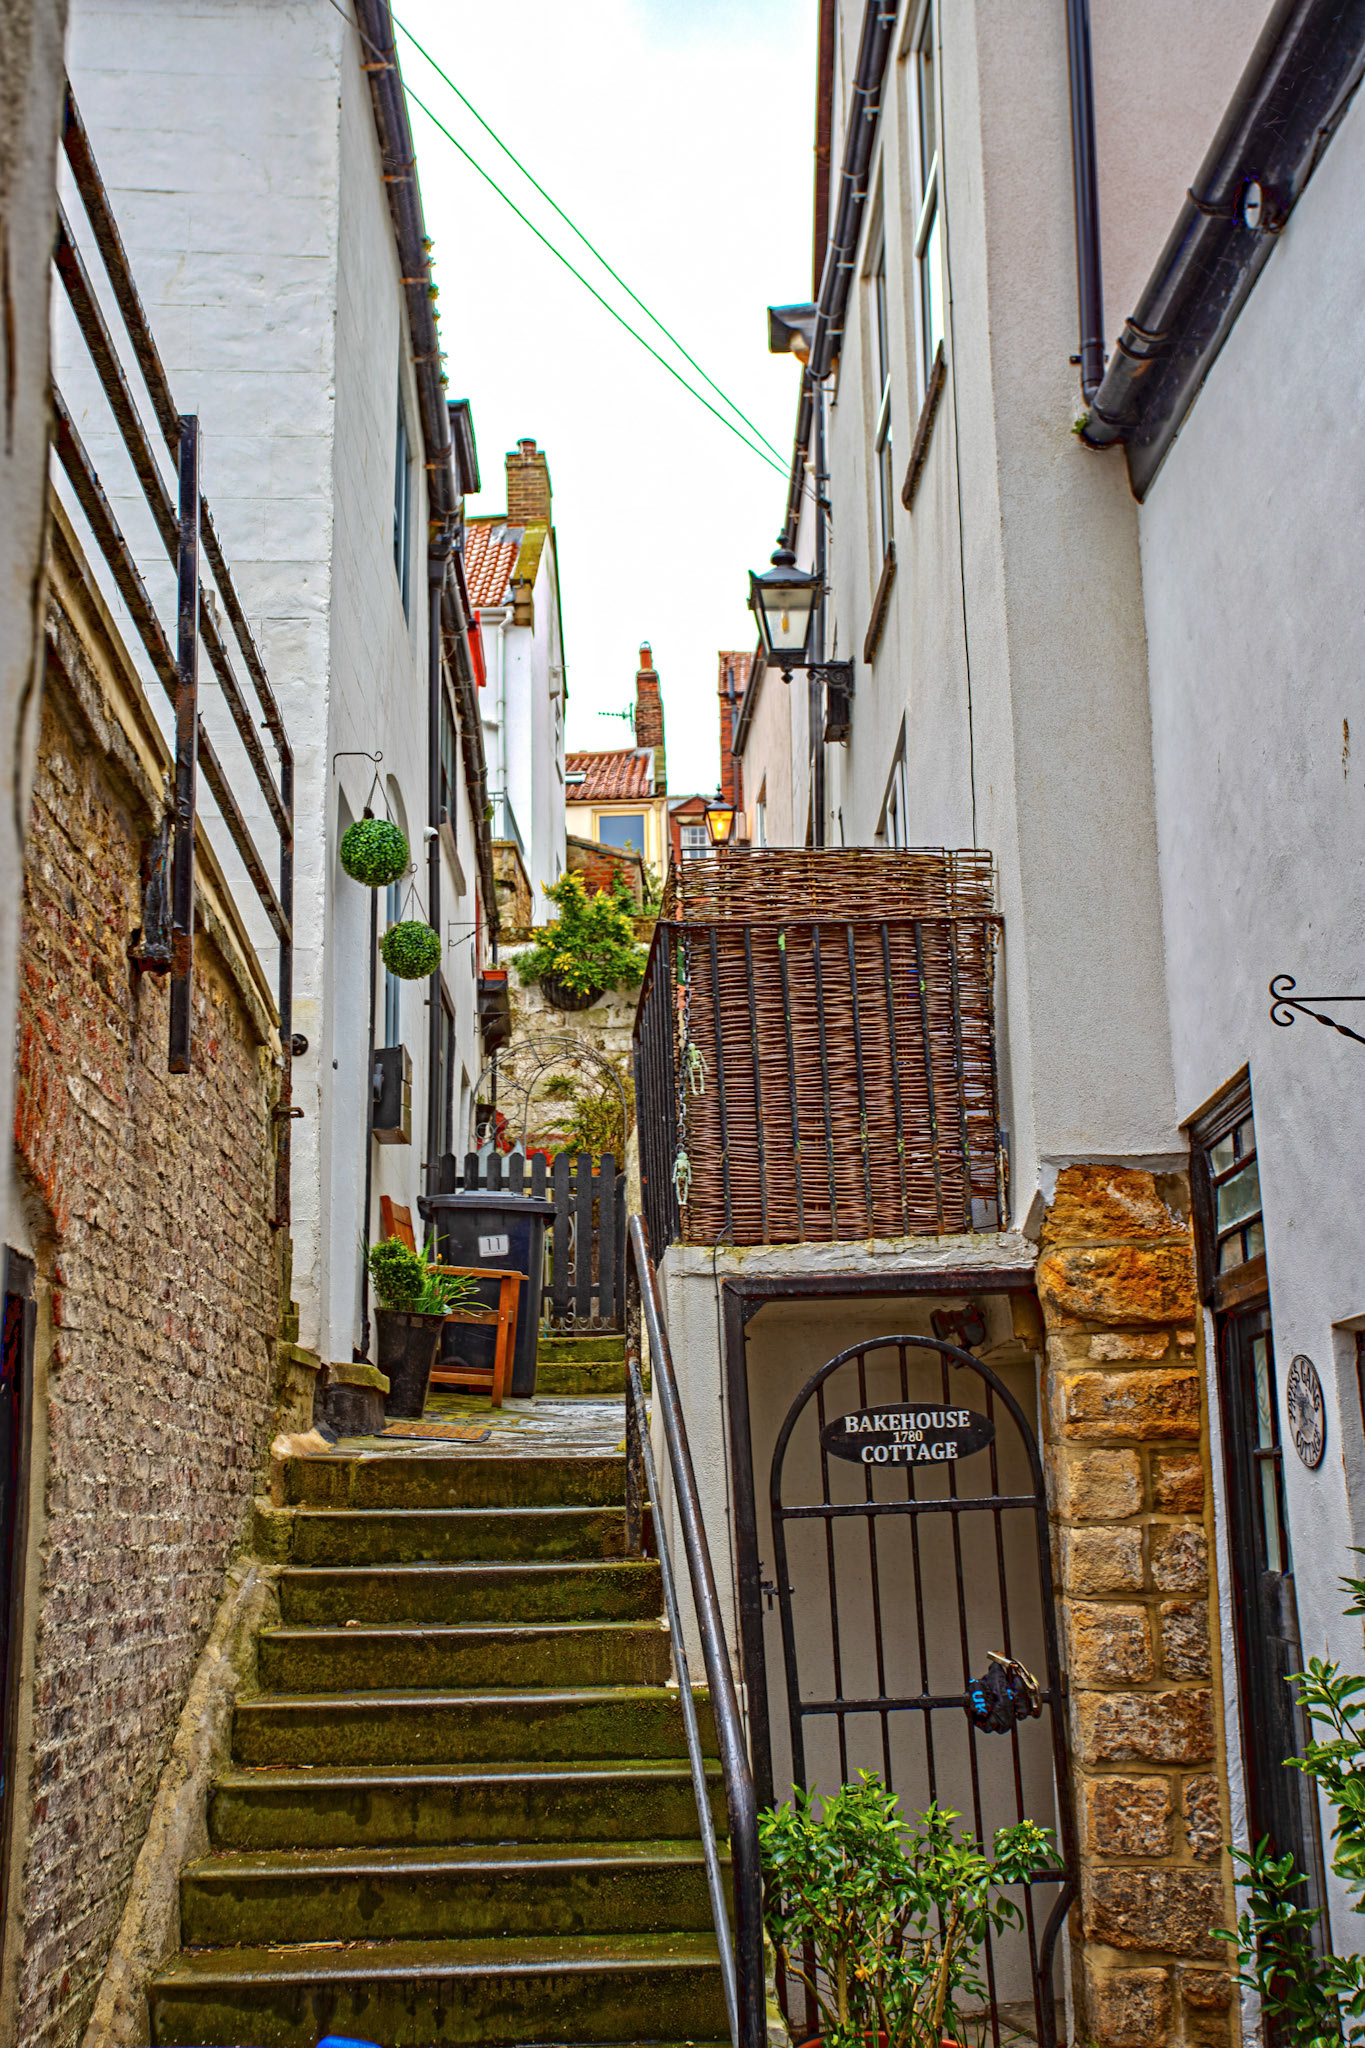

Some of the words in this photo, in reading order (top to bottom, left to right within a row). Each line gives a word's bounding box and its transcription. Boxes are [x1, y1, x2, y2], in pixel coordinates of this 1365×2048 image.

[486, 1237, 501, 1251] 11
[1300, 1360, 1321, 1413] GANG
[844, 1410, 971, 1433] BAKEHOUSE
[893, 1430, 924, 1443] 1780
[1296, 1422, 1321, 1462] COTTAGE
[861, 1441, 959, 1463] COTTAGE
